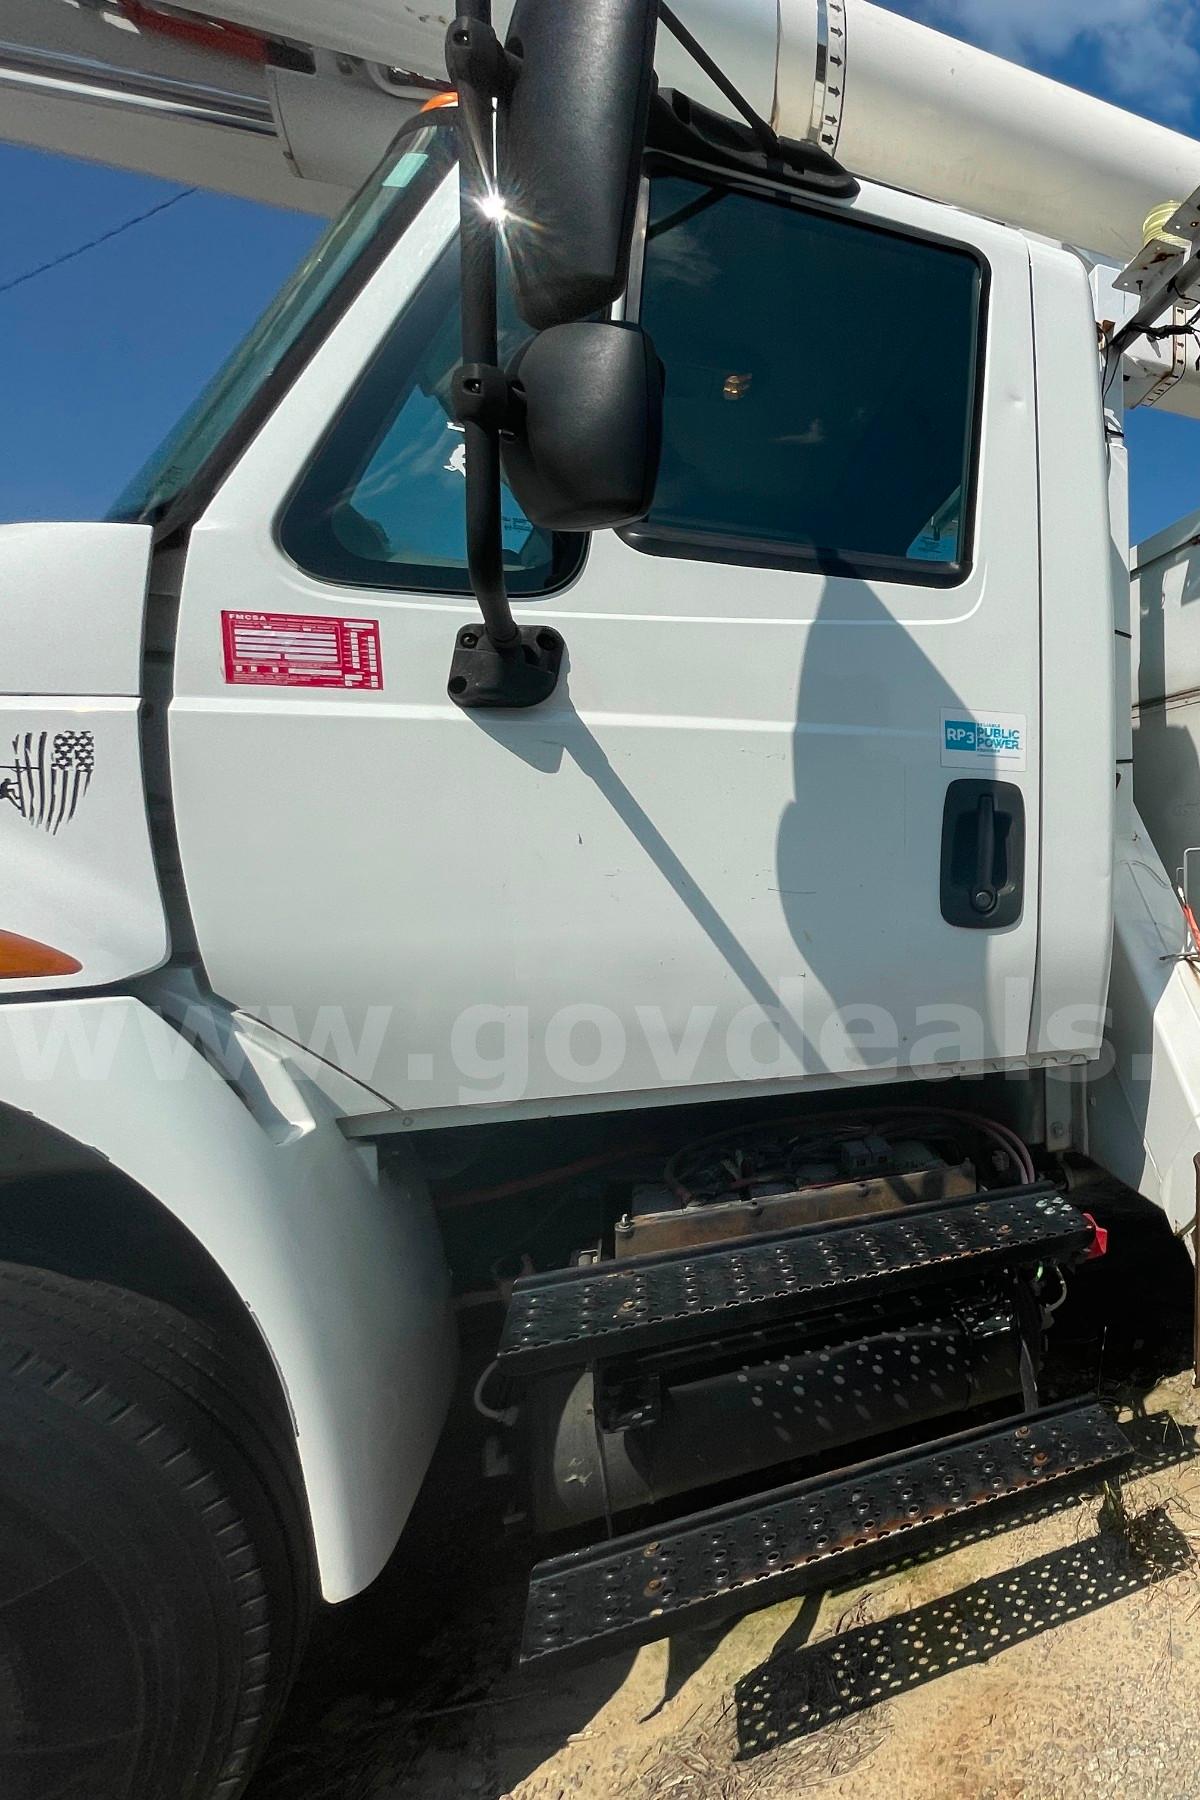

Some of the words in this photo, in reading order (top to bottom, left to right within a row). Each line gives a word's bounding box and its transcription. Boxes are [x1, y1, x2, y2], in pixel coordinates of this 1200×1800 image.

[229, 613, 267, 622] FMCSA
[946, 727, 975, 744] RP3
[976, 727, 1020, 740] PUBLIC
[976, 738, 1020, 750] POWER
